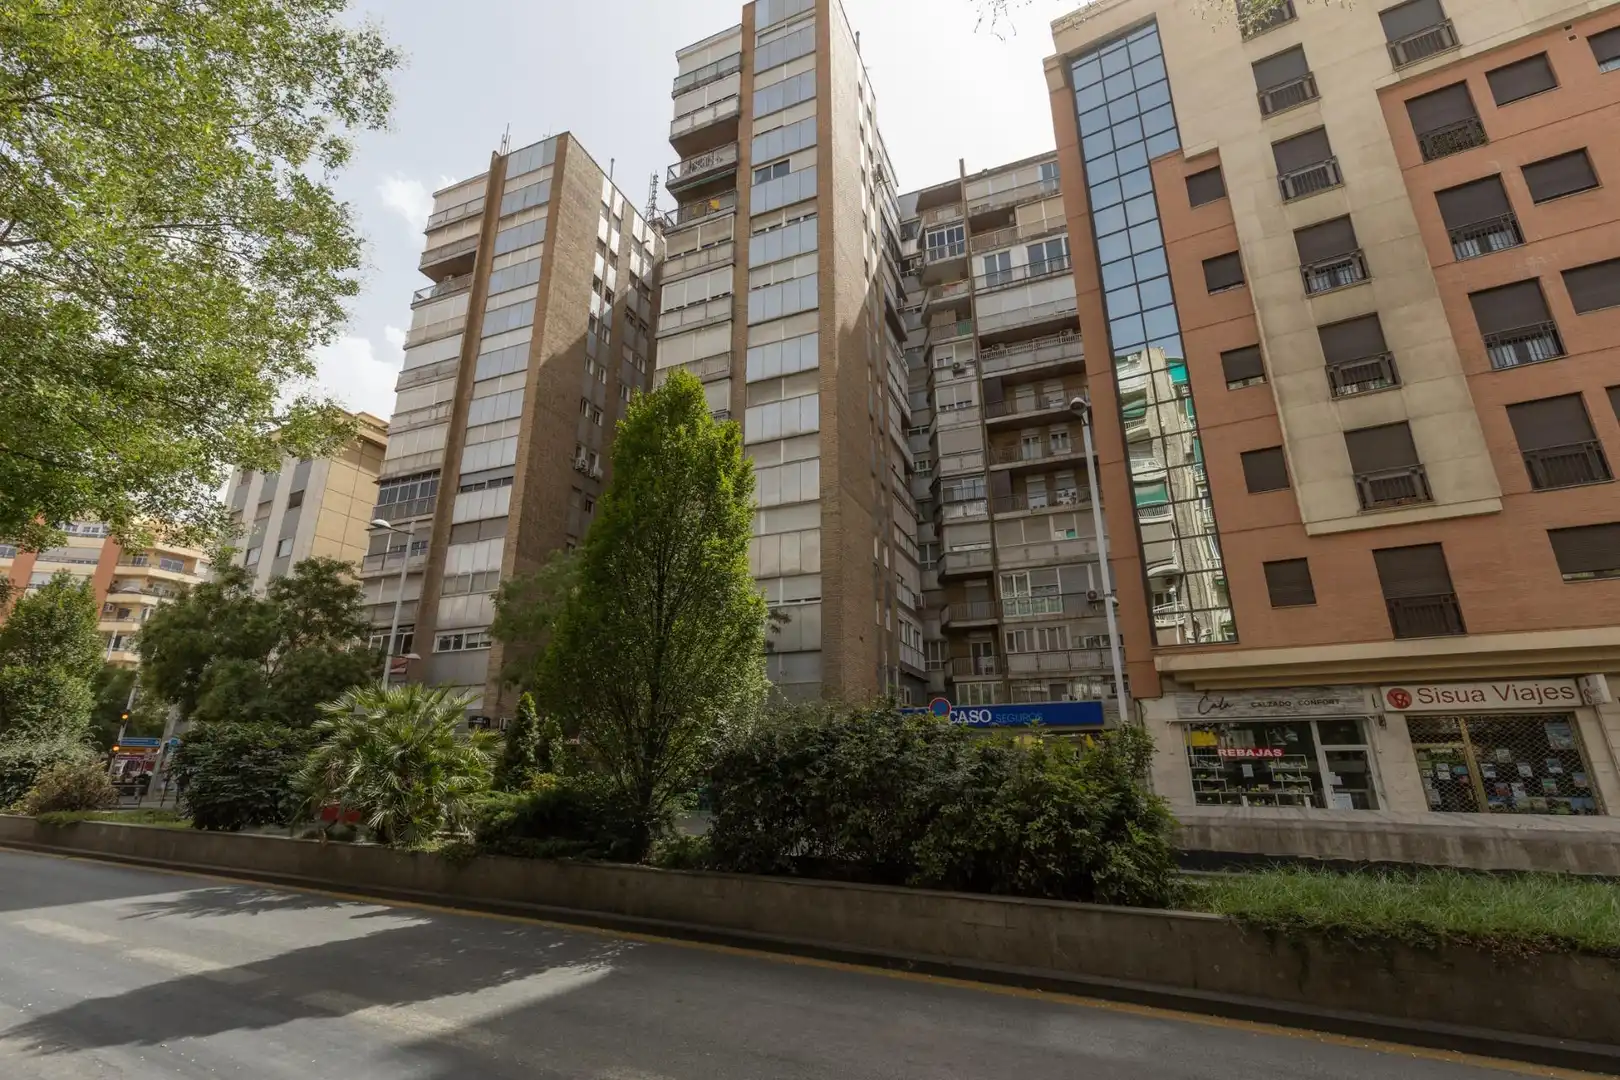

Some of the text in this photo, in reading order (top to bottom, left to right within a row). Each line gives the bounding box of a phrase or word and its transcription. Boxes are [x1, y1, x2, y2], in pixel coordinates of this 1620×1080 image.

[1417, 684, 1575, 704] Sisua Viajes
[1250, 698, 1340, 709] CALZADO CONFORT
[947, 710, 1043, 724] CASO SEGUROS
[1218, 748, 1282, 758] REBAJAS
